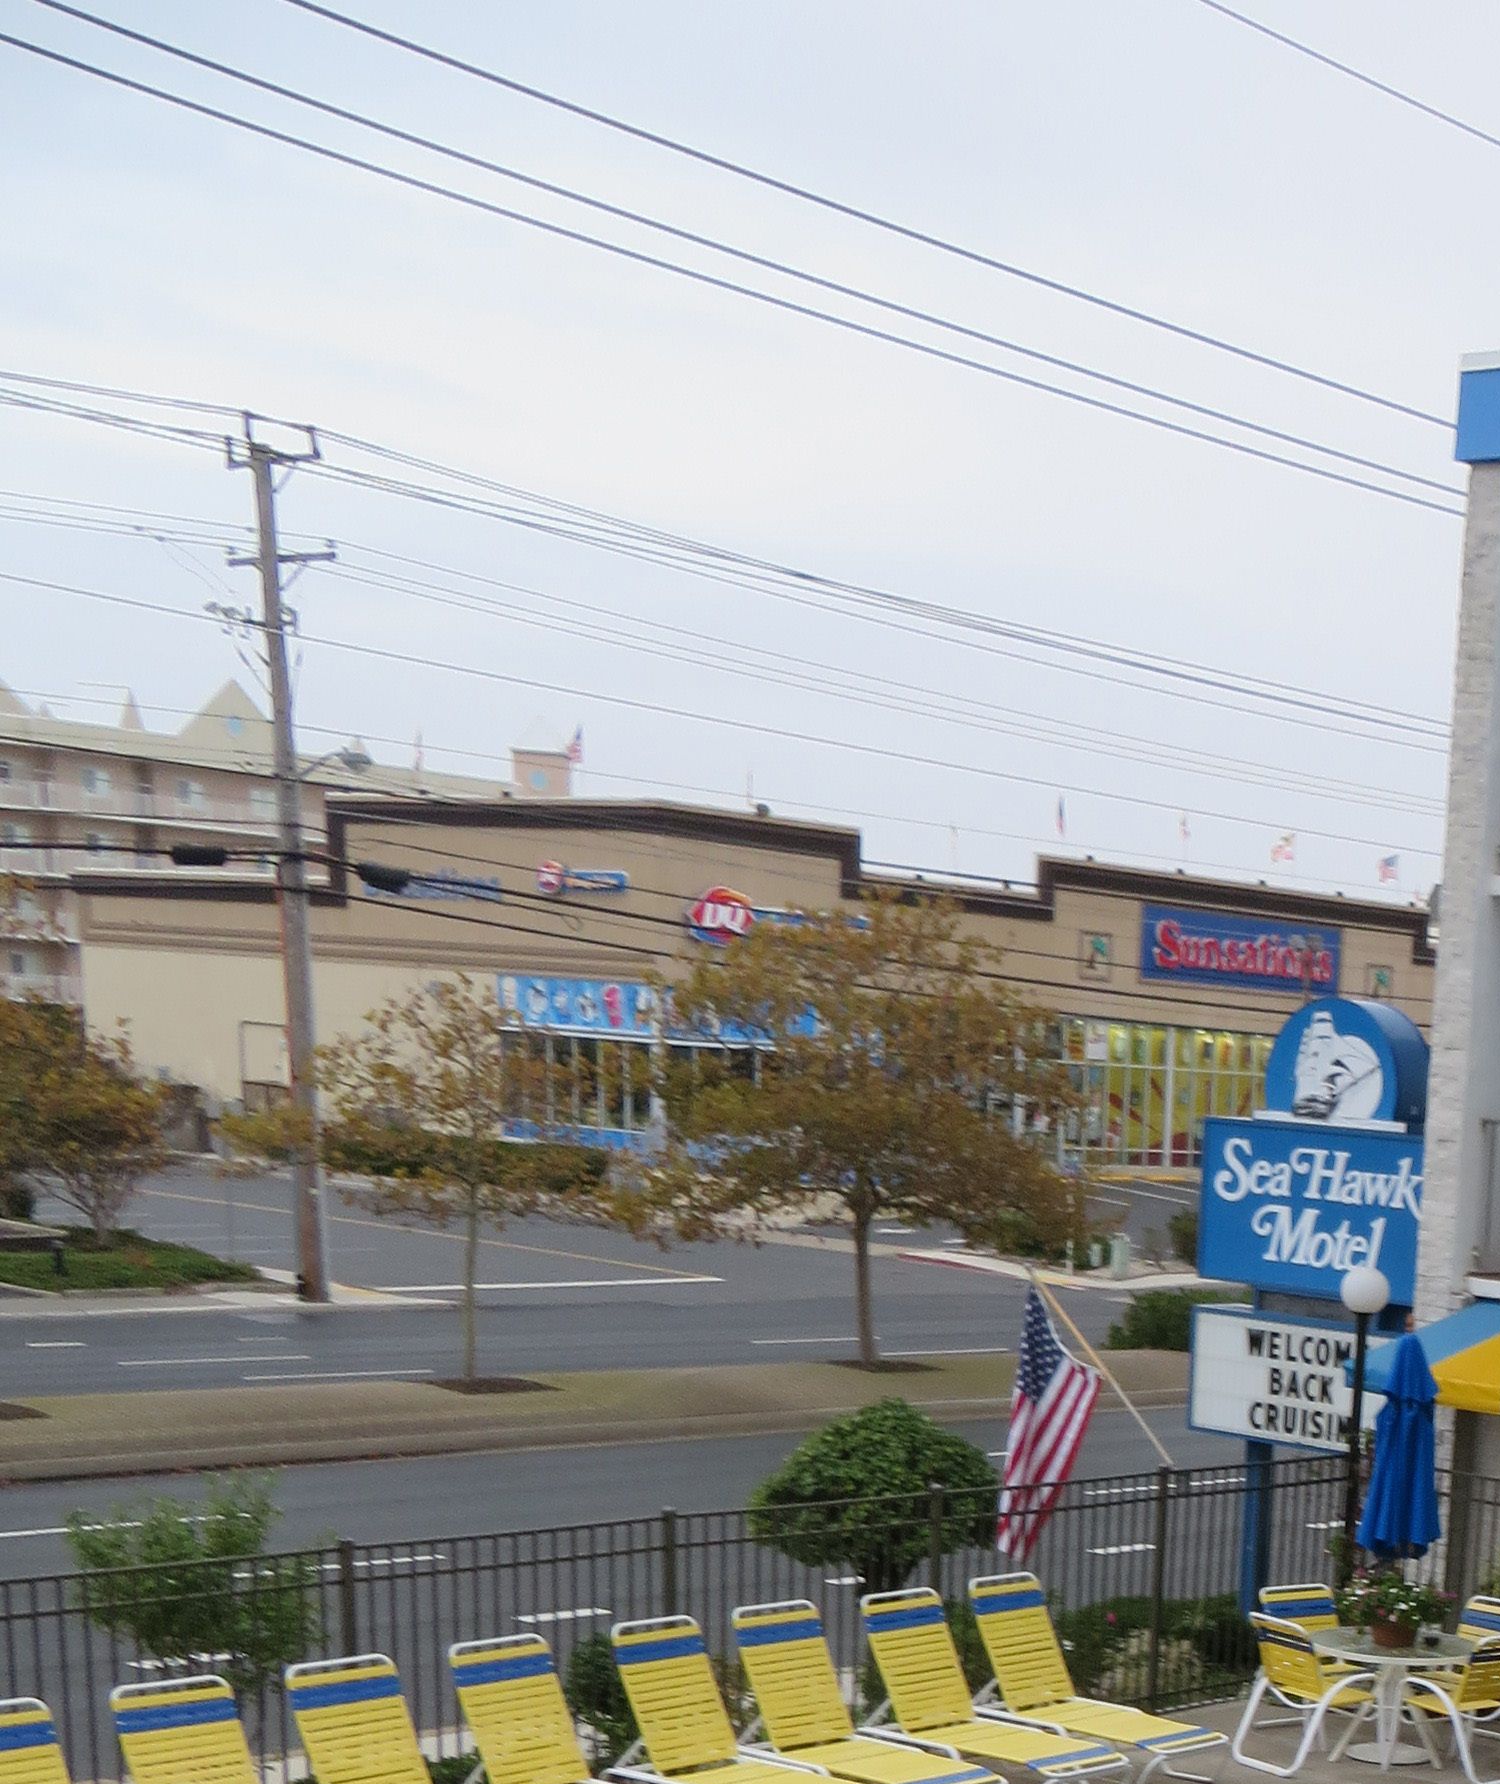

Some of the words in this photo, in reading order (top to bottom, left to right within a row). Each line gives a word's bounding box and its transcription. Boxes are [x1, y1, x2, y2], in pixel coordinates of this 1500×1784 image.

[702, 902, 748, 935] DQ
[1213, 1137, 1293, 1202] Sea
[1290, 1147, 1424, 1221] Hawk
[1251, 1203, 1387, 1271] Motel
[1269, 1366, 1334, 1405] BACK
